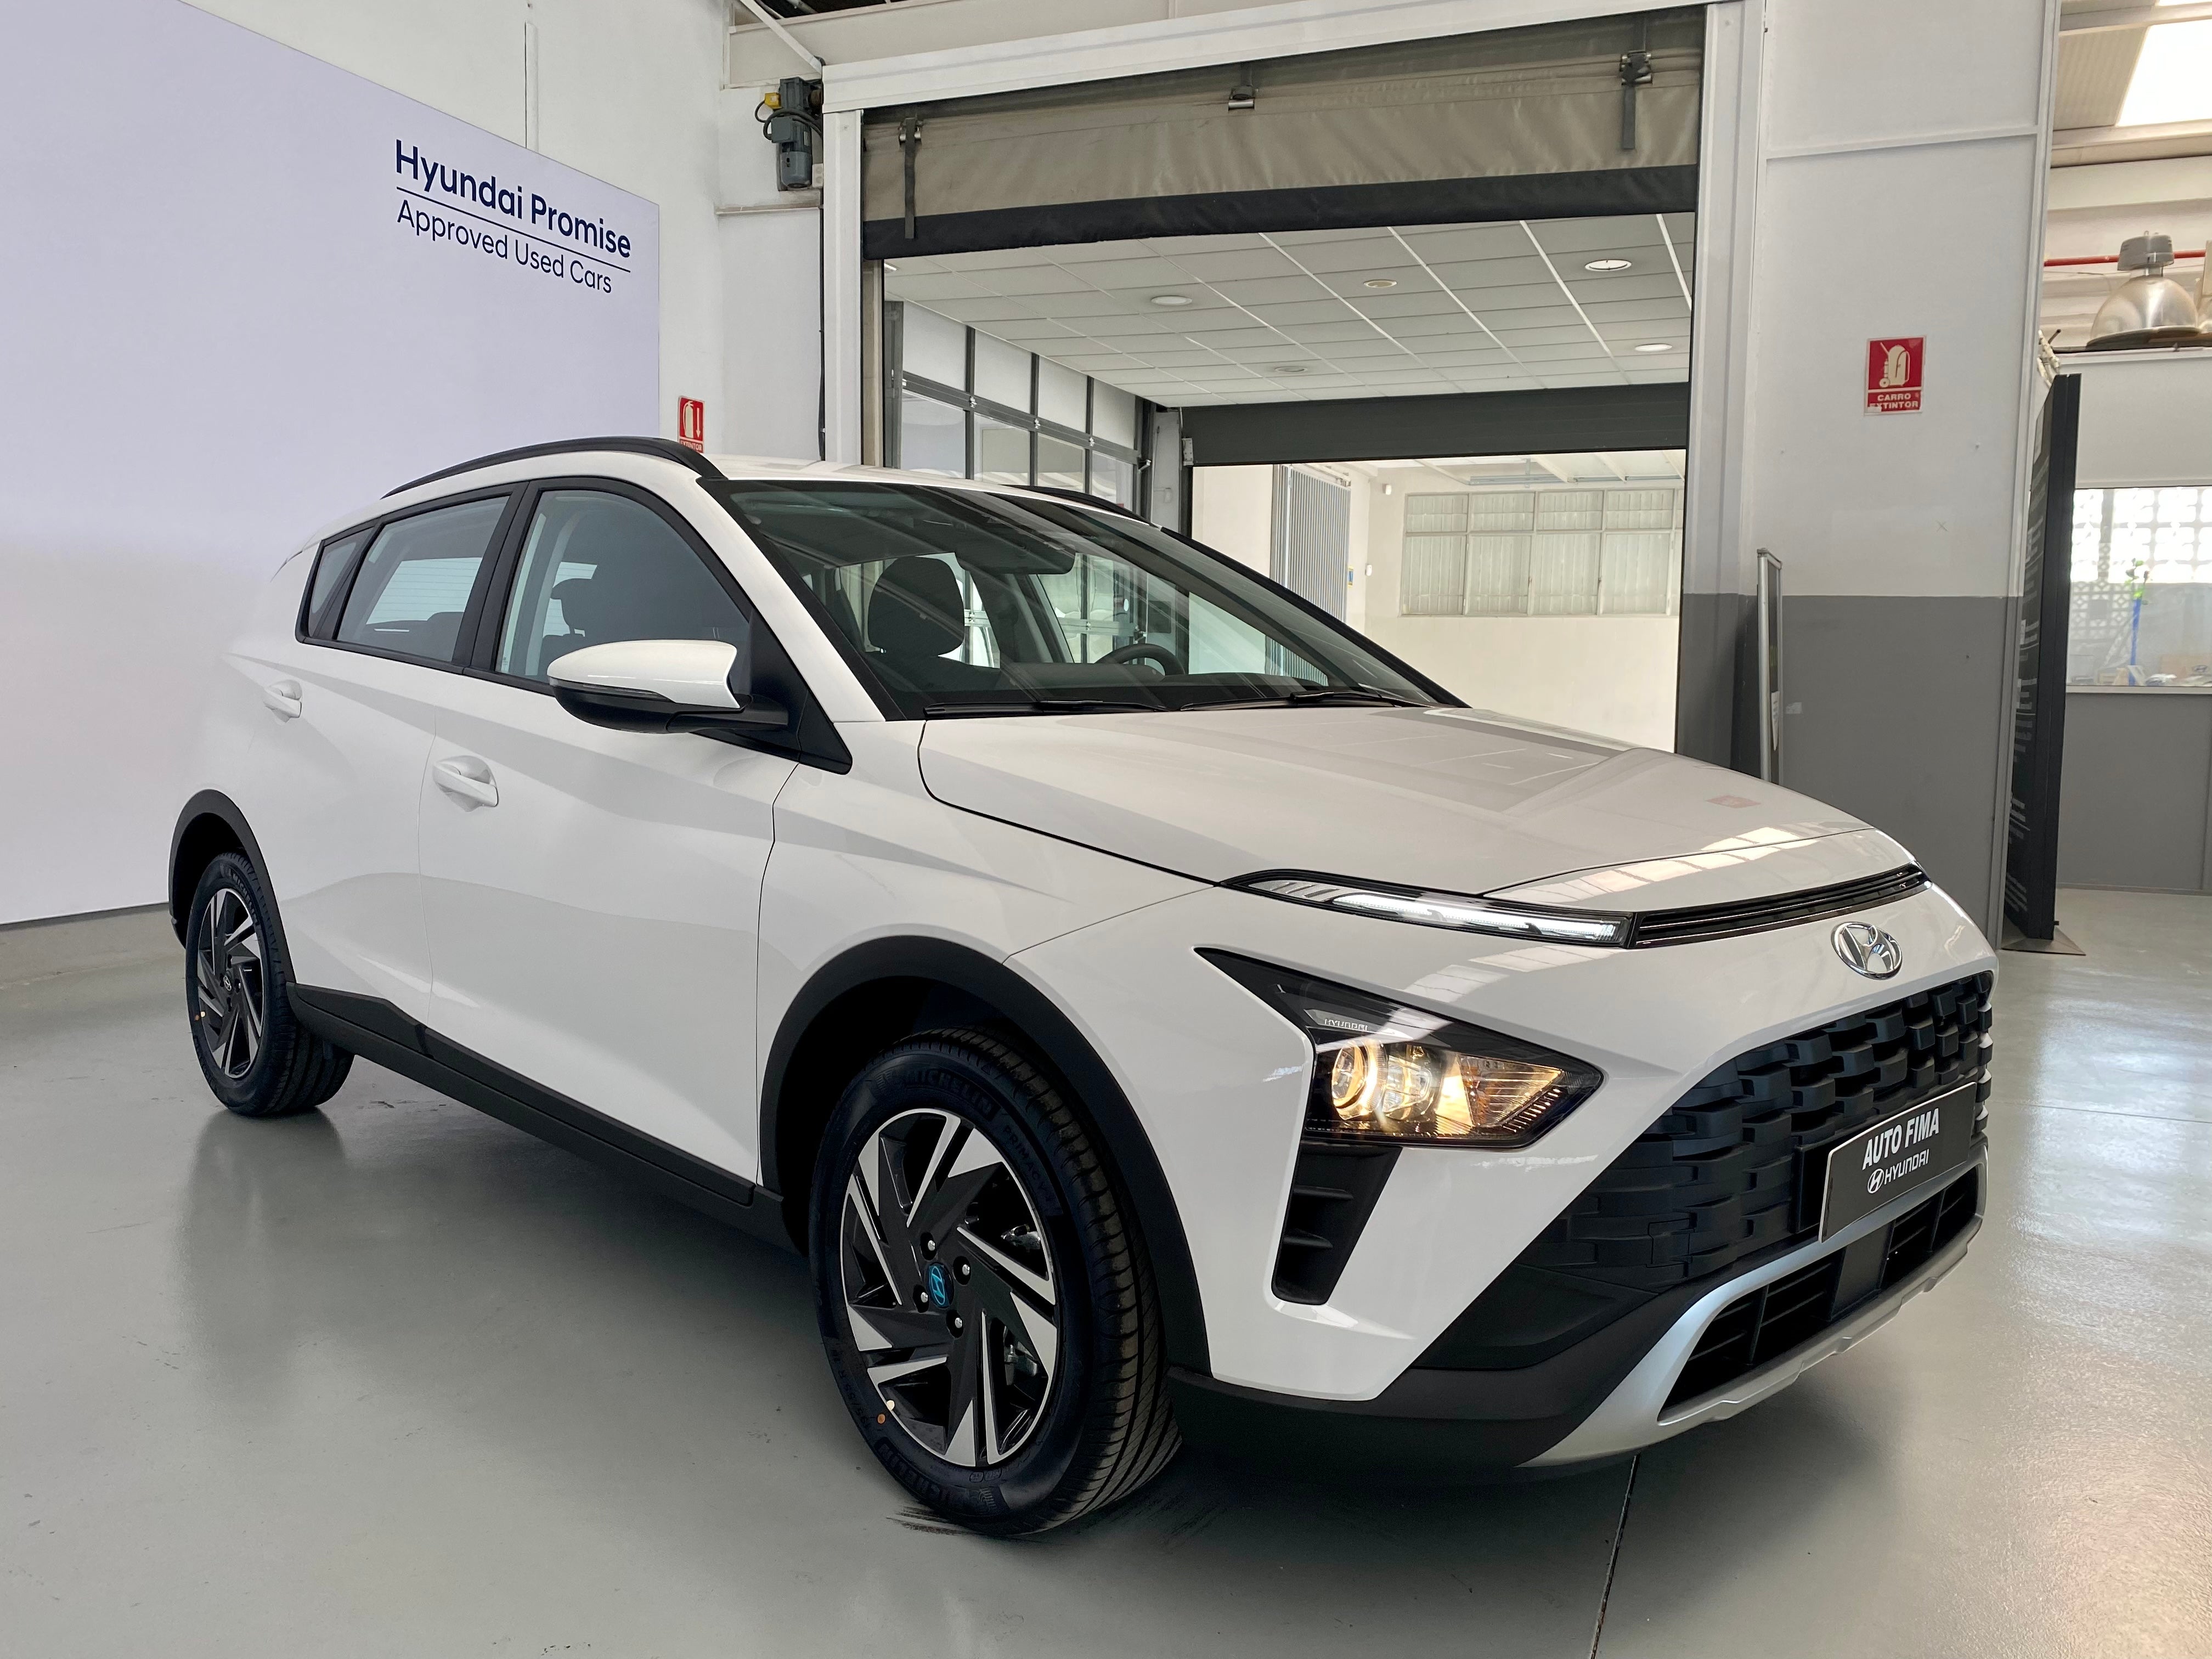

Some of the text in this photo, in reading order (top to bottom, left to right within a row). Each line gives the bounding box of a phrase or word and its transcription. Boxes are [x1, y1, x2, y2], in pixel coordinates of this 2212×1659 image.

[396, 139, 631, 258] Hyundai Promise
[397, 199, 612, 294] Approved Used Cars
[1877, 393, 1911, 401] CARRO
[1324, 1018, 1369, 1031] HYUNDAI
[907, 1069, 994, 1116] MICHELIN
[1002, 1125, 1047, 1191] PRIMACY
[1862, 1107, 1940, 1171] AUTO FIMA
[1884, 1148, 1930, 1186] HYUNDAI
